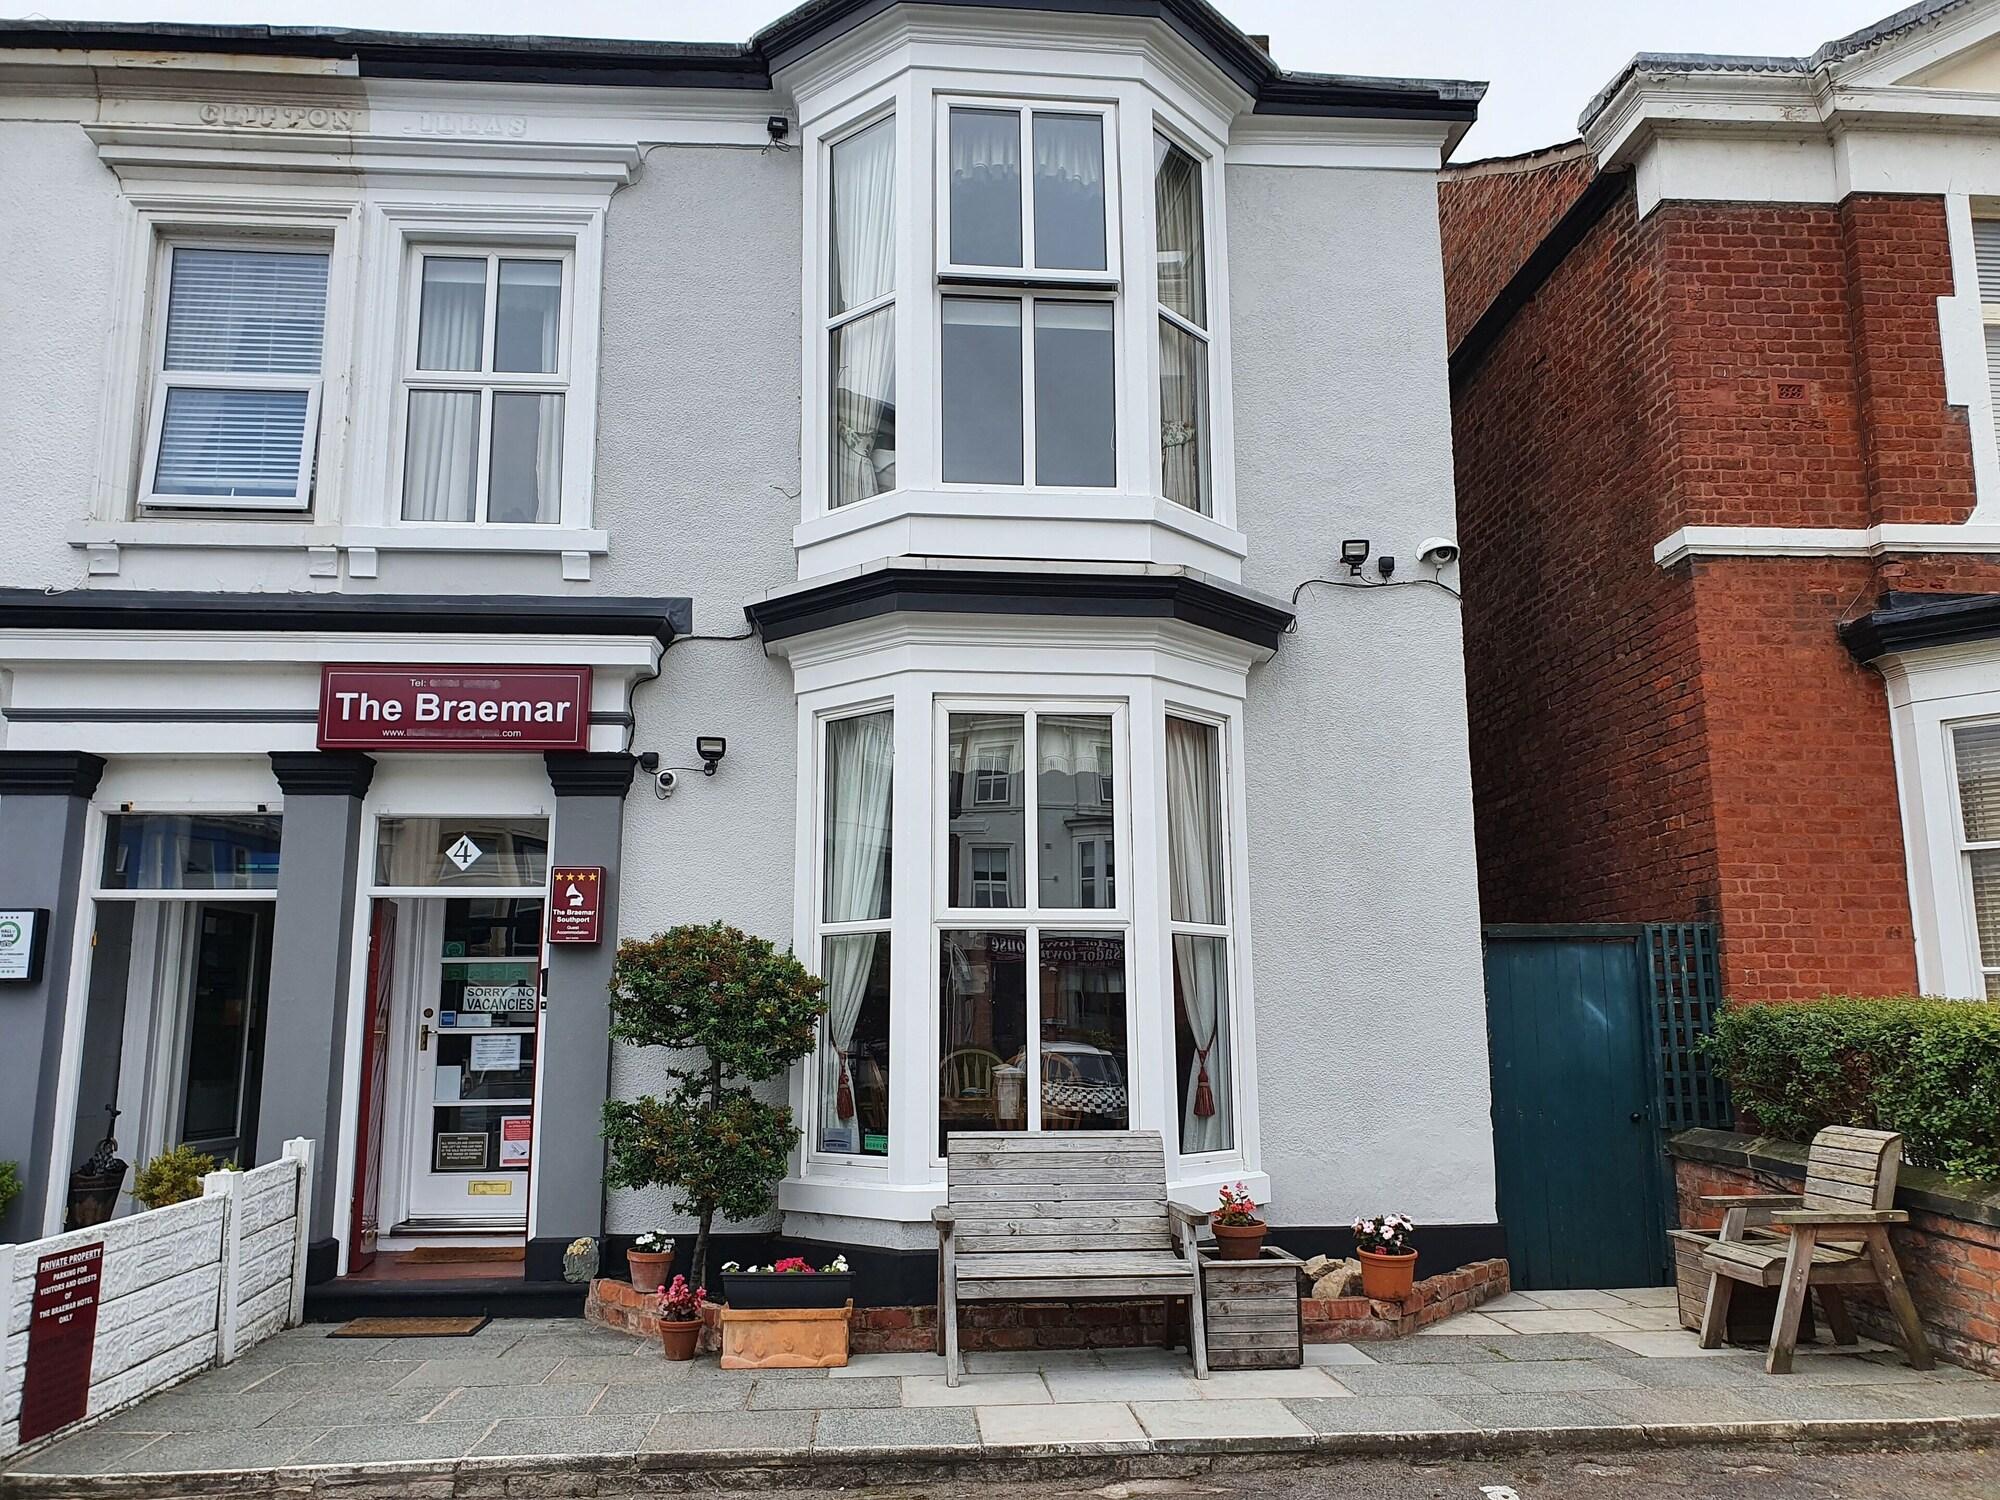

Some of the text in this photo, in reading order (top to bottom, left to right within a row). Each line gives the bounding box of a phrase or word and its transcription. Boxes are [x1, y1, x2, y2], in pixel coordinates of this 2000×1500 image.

[409, 678, 427, 688] Tel:
[335, 692, 571, 722] The Braemar
[453, 840, 473, 863] 4
[557, 916, 590, 924] Southport
[467, 988, 507, 997] SORRY
[517, 987, 535, 997] NO
[467, 998, 534, 1011] VACANCIES
[40, 1248, 102, 1271] PRIVATE PROPERTY
[53, 1266, 87, 1280] PARKING FOR
[40, 1274, 97, 1296] VISITORS AND GUESTS
[64, 1291, 72, 1300] OF
[39, 1296, 93, 1319] THE BRAEMAR HOTEL
[58, 1313, 73, 1324] ONLY
